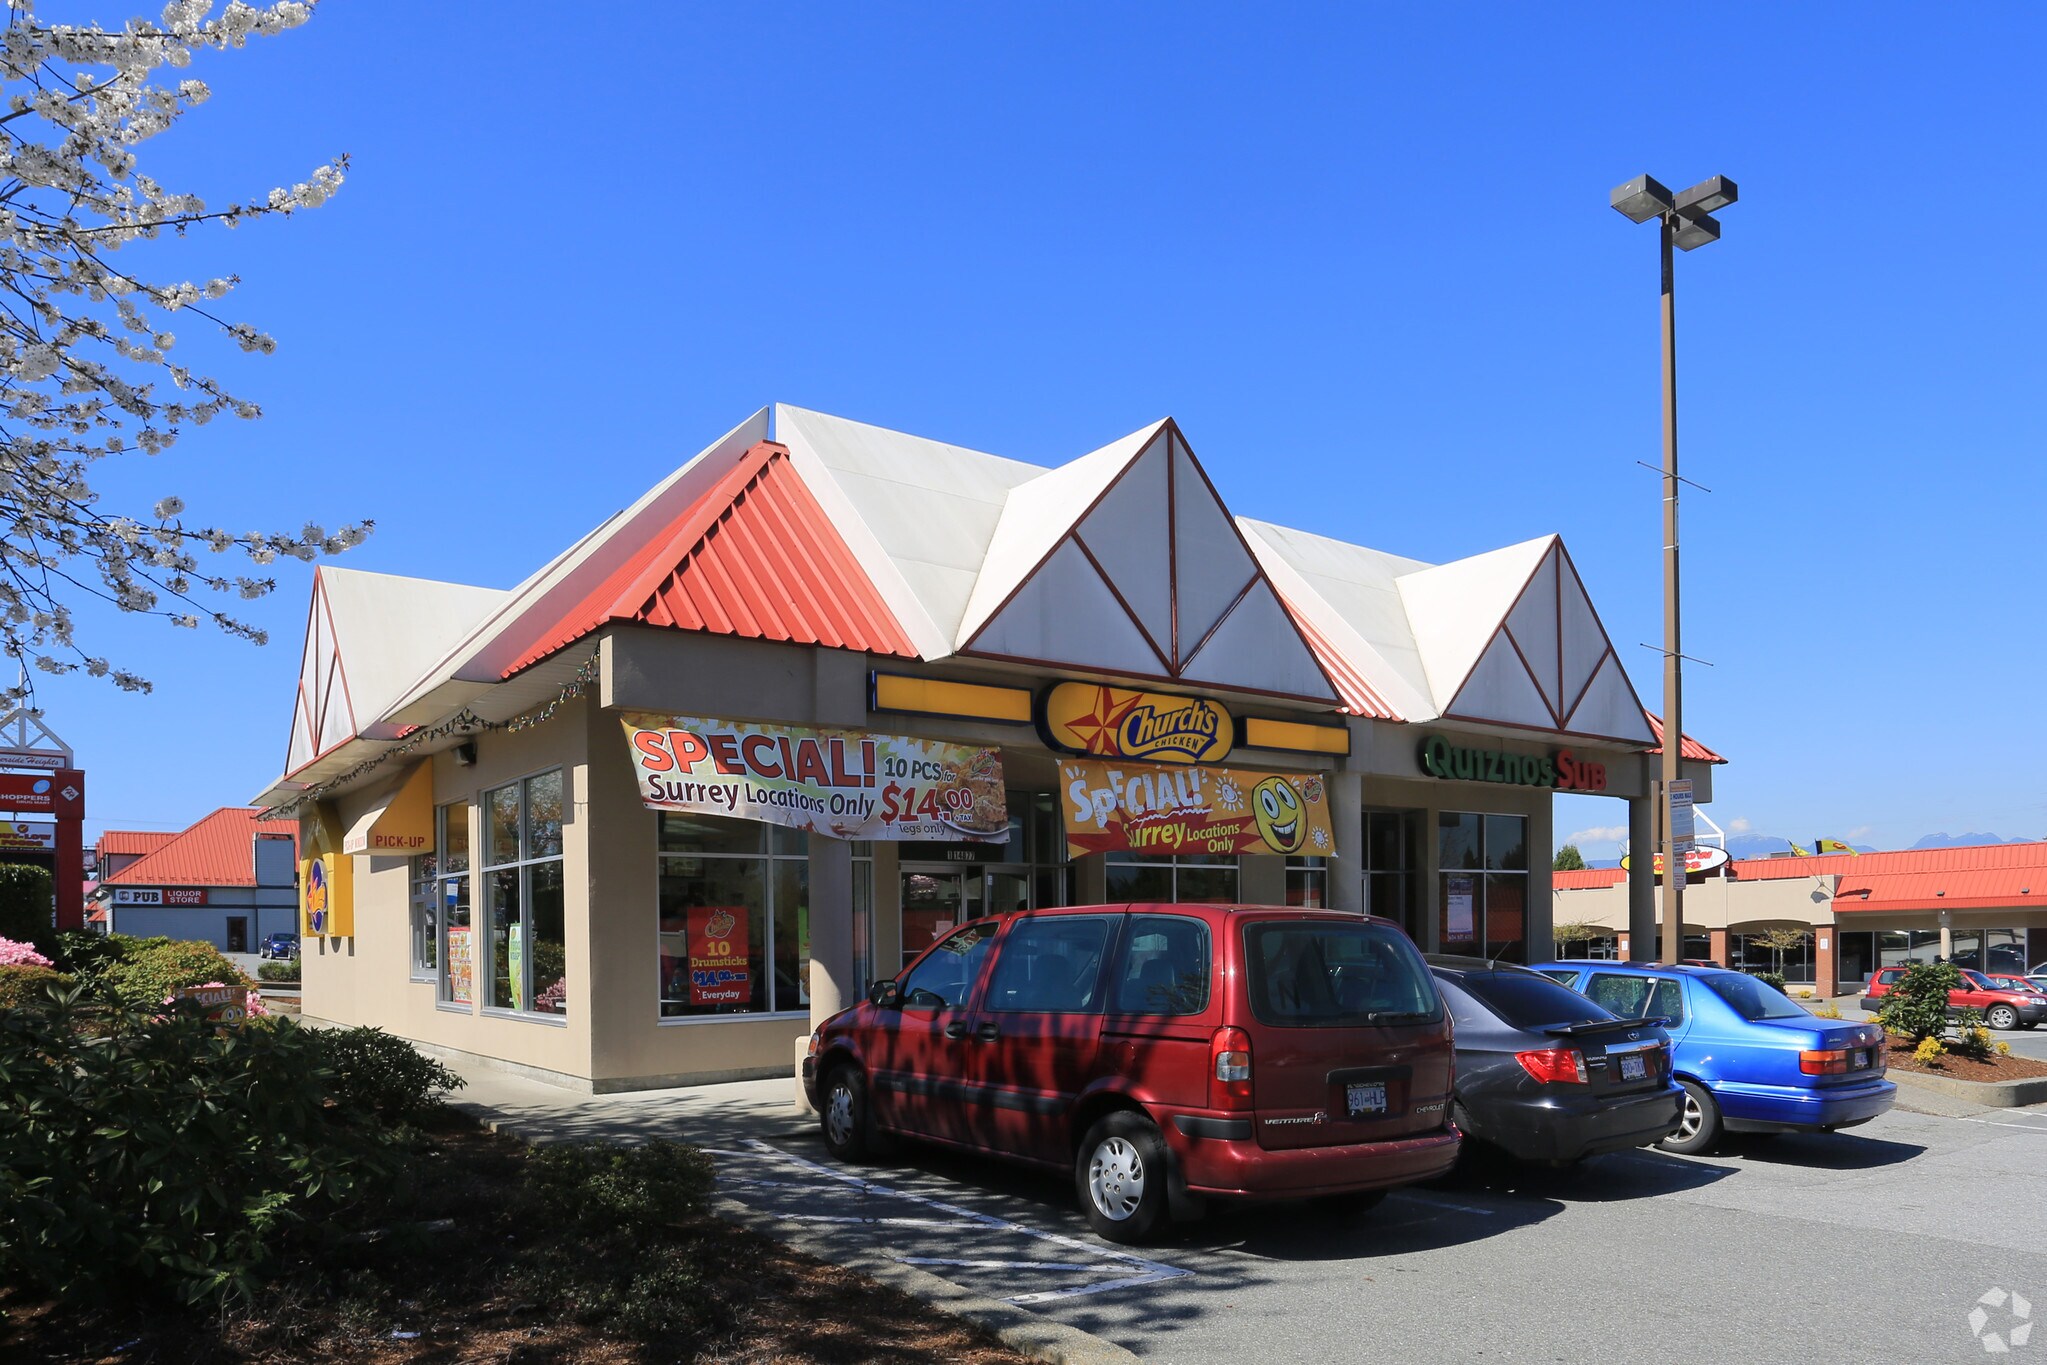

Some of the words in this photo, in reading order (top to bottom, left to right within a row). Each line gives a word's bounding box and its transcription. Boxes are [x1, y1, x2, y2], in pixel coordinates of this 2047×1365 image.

[1119, 701, 1216, 756] Church's
[1155, 737, 1199, 751] CHICKEN
[25, 756, 59, 767] Heights
[634, 731, 876, 788] SPECIAL!
[1420, 734, 1555, 787] Quiznos
[884, 757, 908, 778] 10
[911, 760, 942, 781] PCS
[943, 770, 956, 783] for
[648, 774, 739, 811] Surrey
[745, 782, 825, 814] Locations
[829, 792, 876, 821] Only
[899, 824, 923, 835] legs
[924, 824, 946, 835] only
[1123, 822, 1187, 850] Surrey
[1187, 823, 1240, 842] Locations
[375, 835, 425, 848] PICK-UP
[1207, 837, 1235, 853] Only
[133, 891, 159, 902] PUB
[707, 941, 731, 956] 10
[691, 956, 748, 967] Drumsticks
[702, 990, 740, 1000] Everyday
[1416, 1103, 1445, 1113] CHEVROLET
[1264, 1117, 1314, 1125] VENTURE
